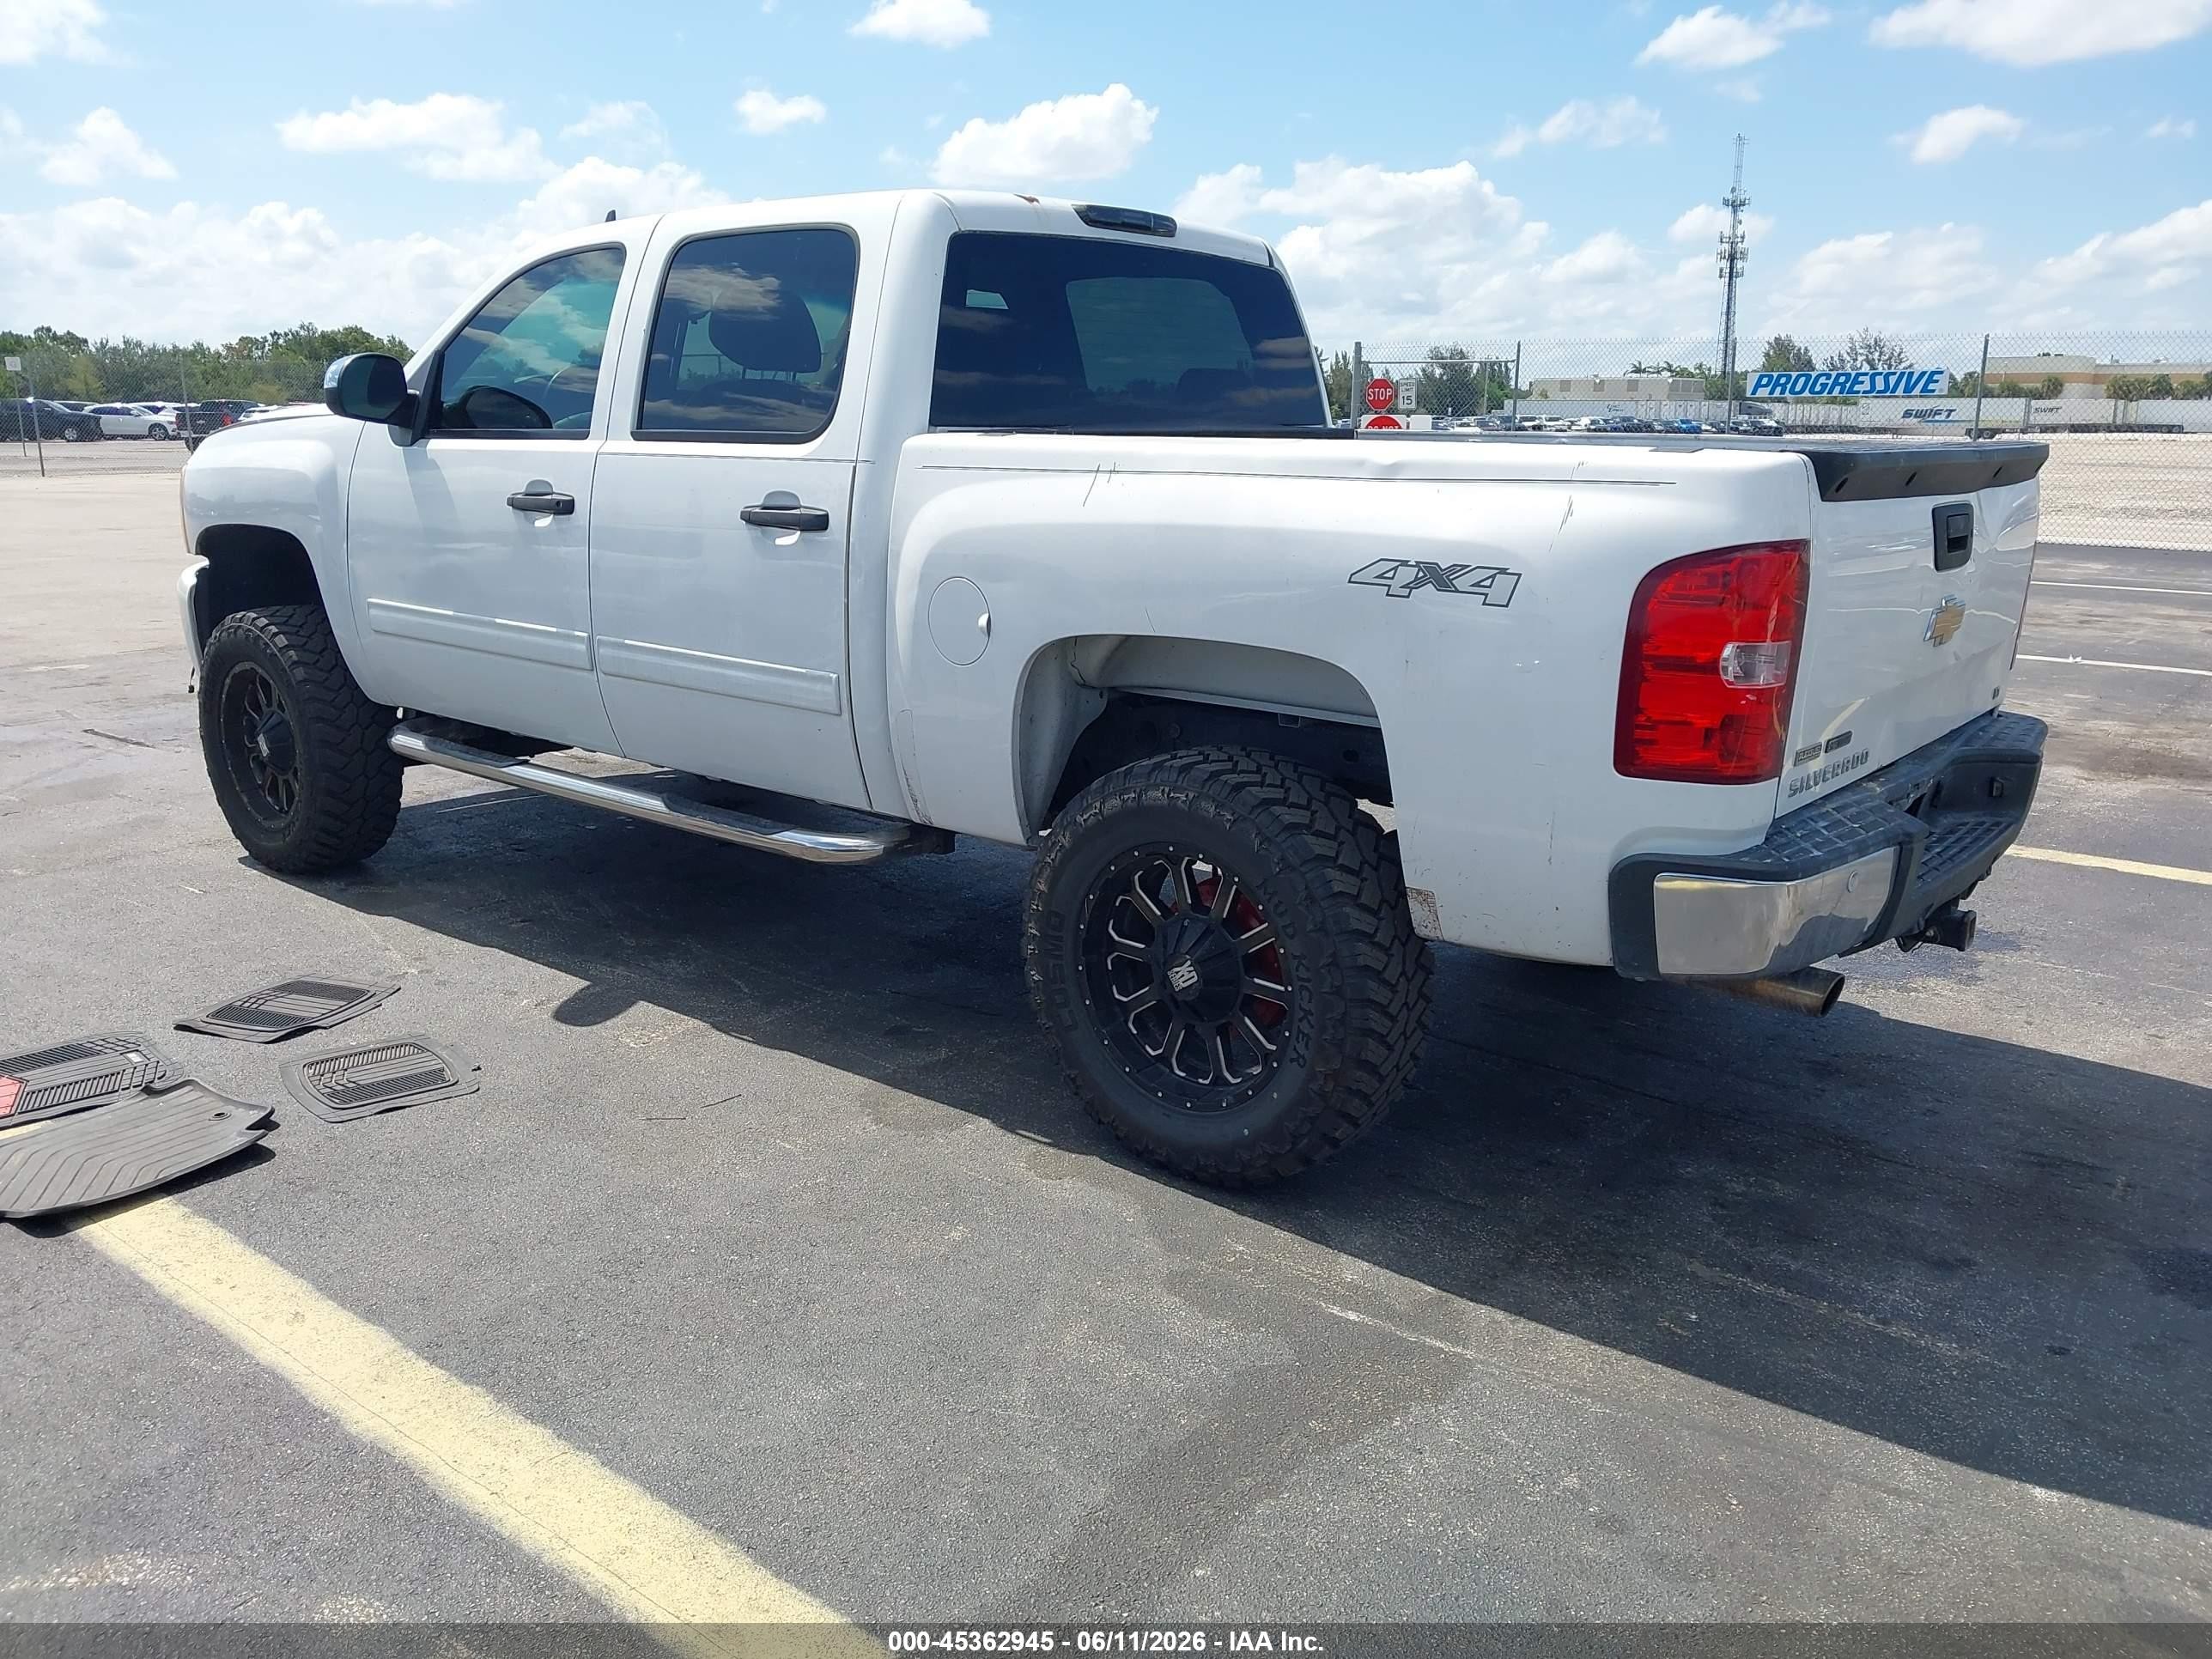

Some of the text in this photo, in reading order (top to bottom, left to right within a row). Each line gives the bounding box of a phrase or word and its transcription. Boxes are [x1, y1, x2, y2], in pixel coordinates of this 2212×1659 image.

[1368, 388, 1392, 400] STOP
[1750, 370, 1944, 396] PROGRESSIVE
[1401, 395, 1413, 405] 15
[1901, 406, 1957, 419] SWIFT
[1787, 748, 1869, 798] SILVERADO
[1167, 970, 1182, 992] SERIES
[1255, 876, 1315, 1069] MUD KICKER
